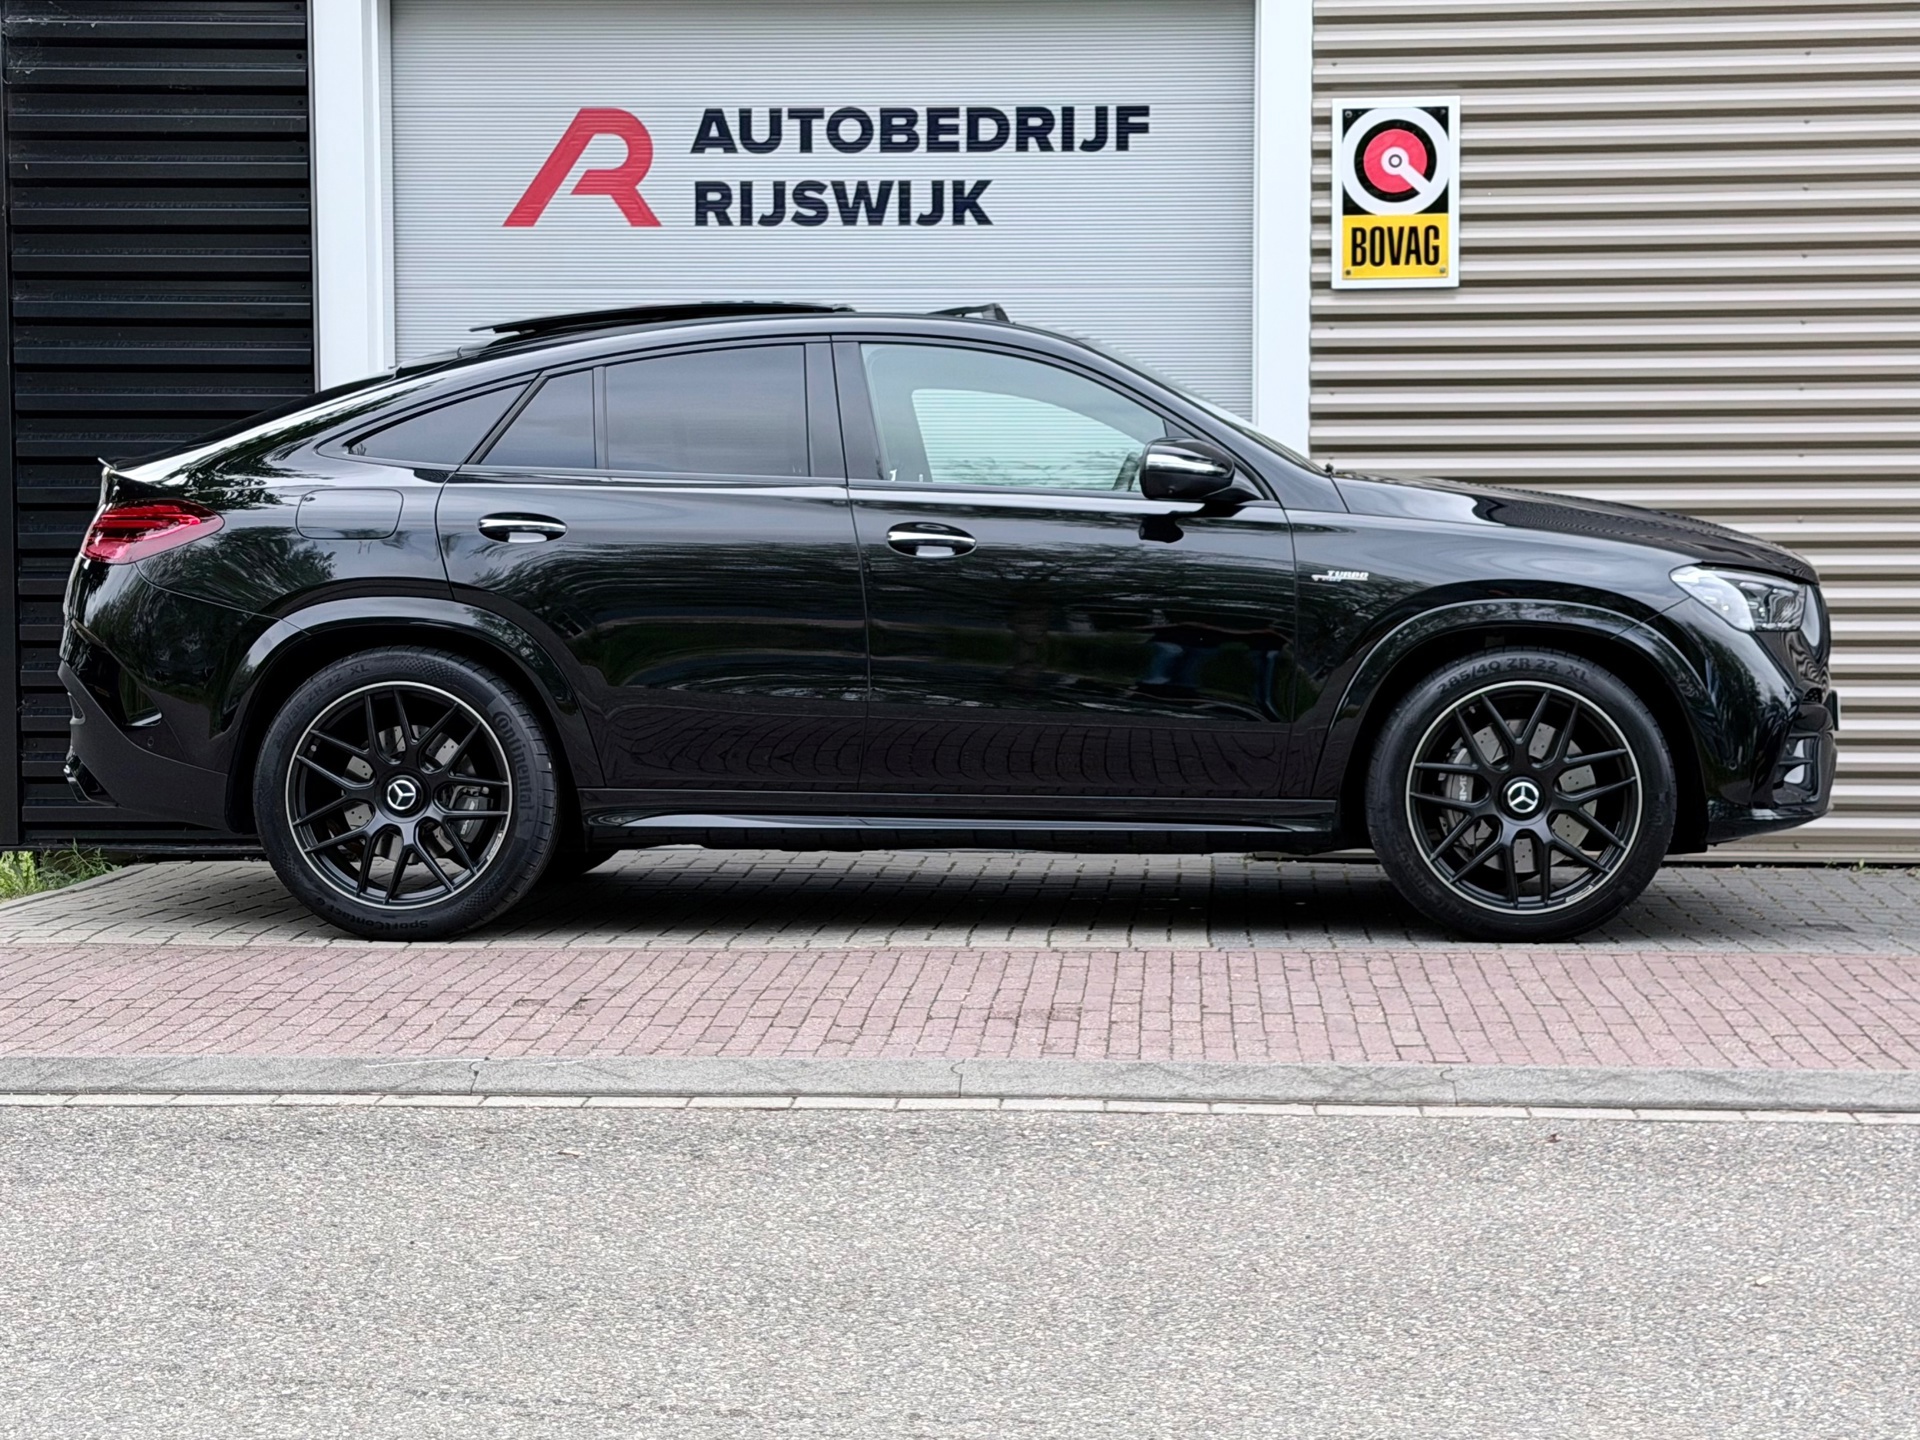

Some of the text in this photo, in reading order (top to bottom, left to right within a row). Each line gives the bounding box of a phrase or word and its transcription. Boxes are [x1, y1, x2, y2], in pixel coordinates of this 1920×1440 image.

[690, 105, 1151, 154] AUTOBEDRIJF
[694, 179, 994, 227] RIJSWIJK
[1350, 225, 1440, 267] BOVAG
[1327, 569, 1370, 580] TURBO
[350, 664, 370, 676] XL
[1437, 658, 1589, 695] 285/40 ZR 22 XL
[492, 711, 535, 810] Continental
[328, 904, 429, 931] SportContact
